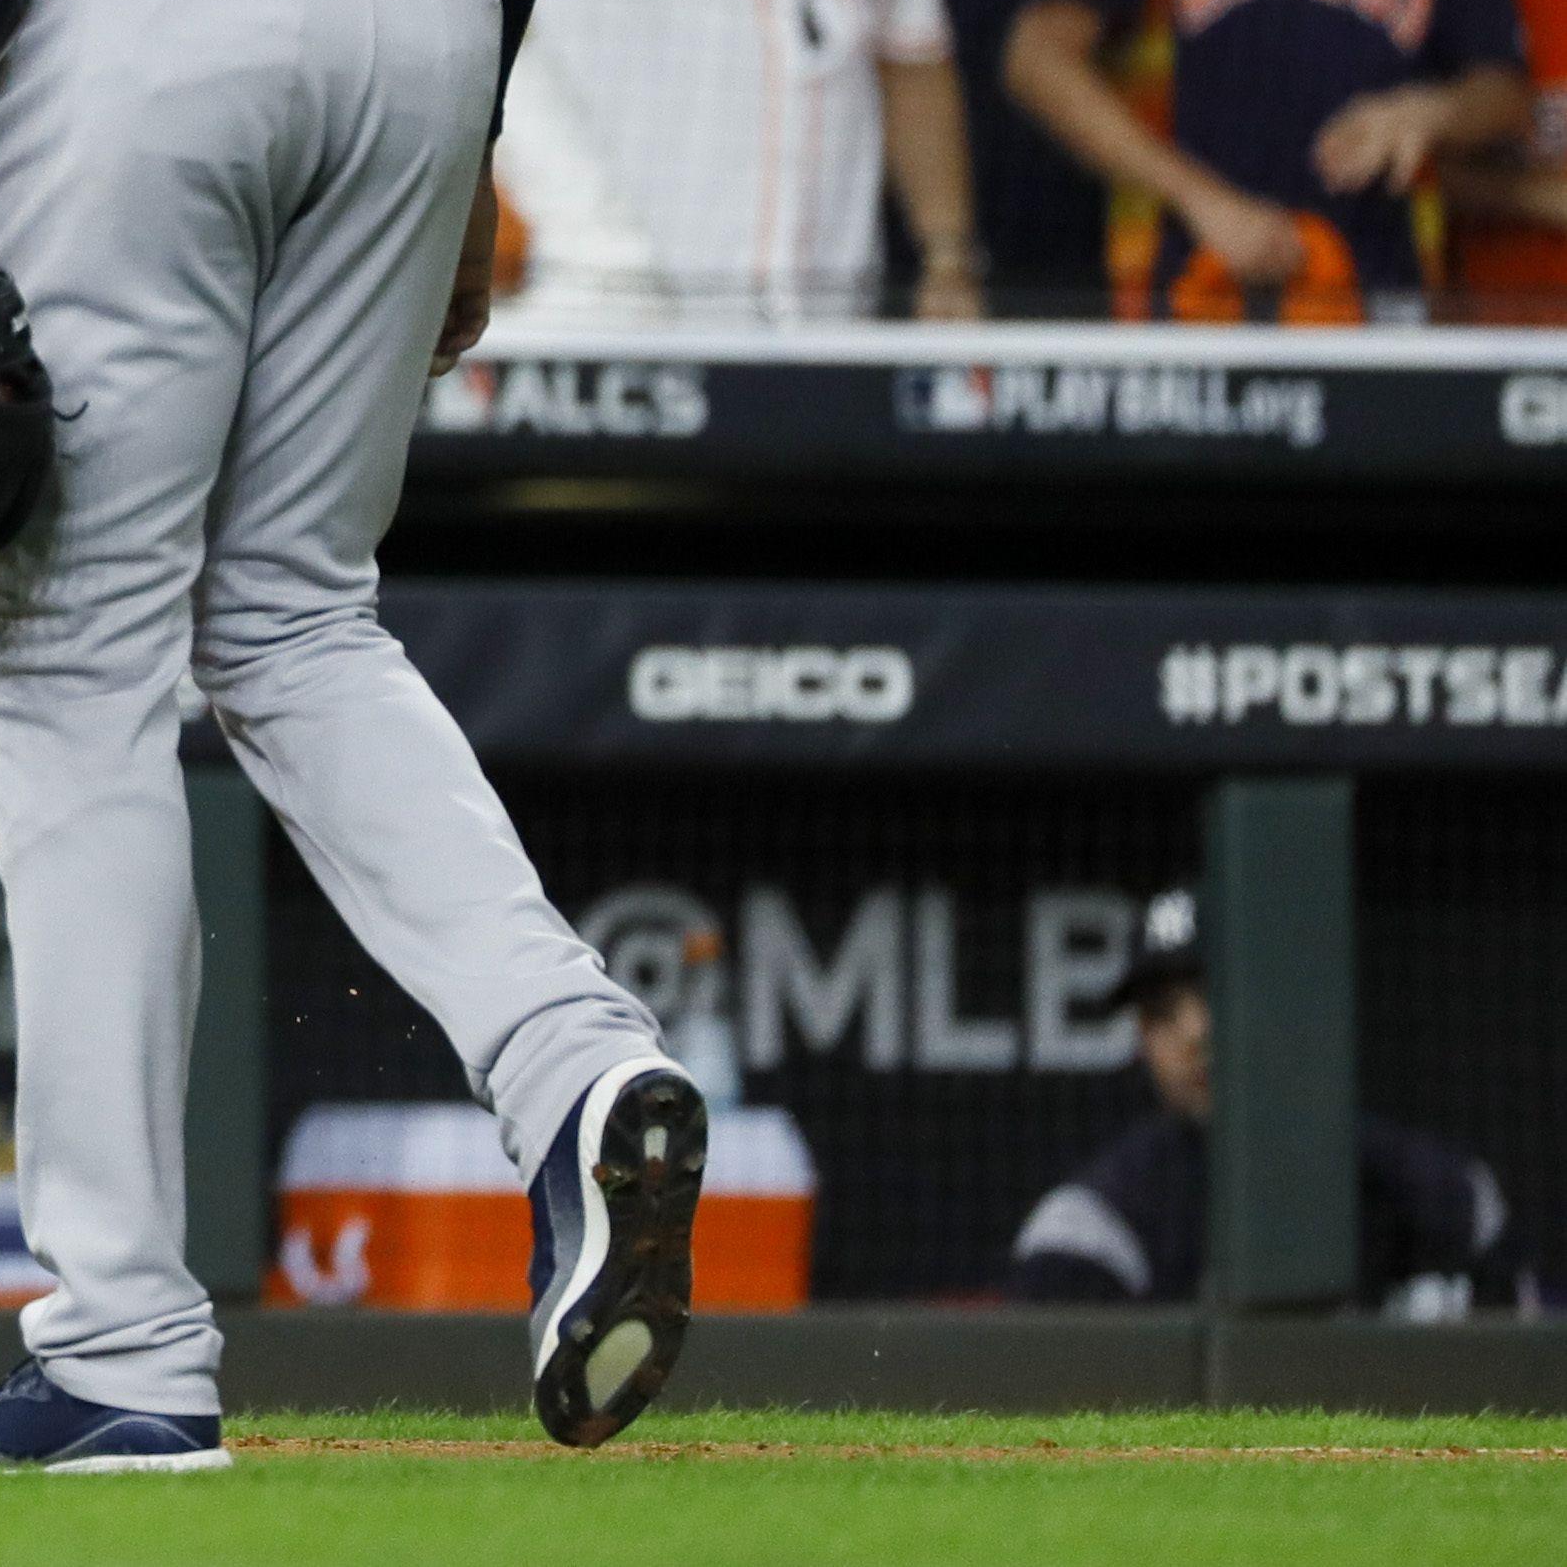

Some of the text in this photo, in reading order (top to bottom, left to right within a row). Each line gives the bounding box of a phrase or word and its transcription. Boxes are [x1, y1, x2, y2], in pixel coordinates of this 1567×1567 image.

[494, 362, 709, 436] ALCS
[629, 647, 914, 722] GEICO
[1160, 646, 1567, 725] #POSTSE
